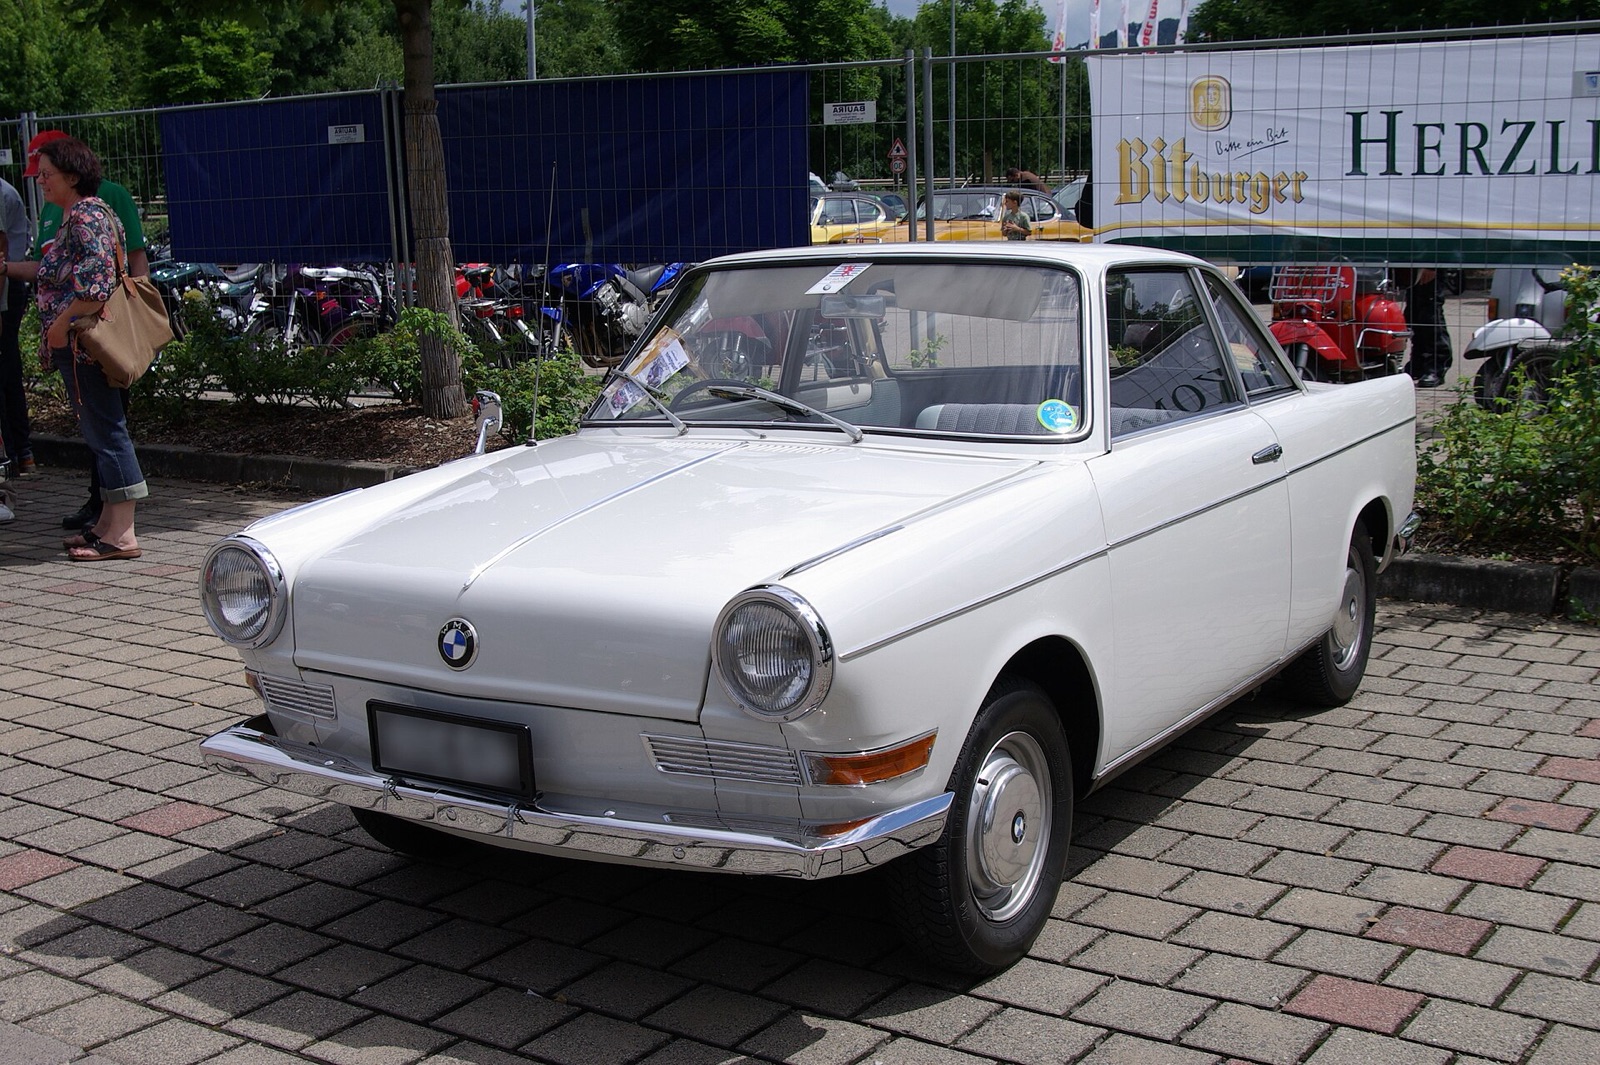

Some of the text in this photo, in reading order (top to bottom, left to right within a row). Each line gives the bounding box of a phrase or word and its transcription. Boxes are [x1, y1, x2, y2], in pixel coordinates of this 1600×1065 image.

[1215, 127, 1289, 156] Bitte ein Bit
[1114, 136, 1309, 215] Bitburger
